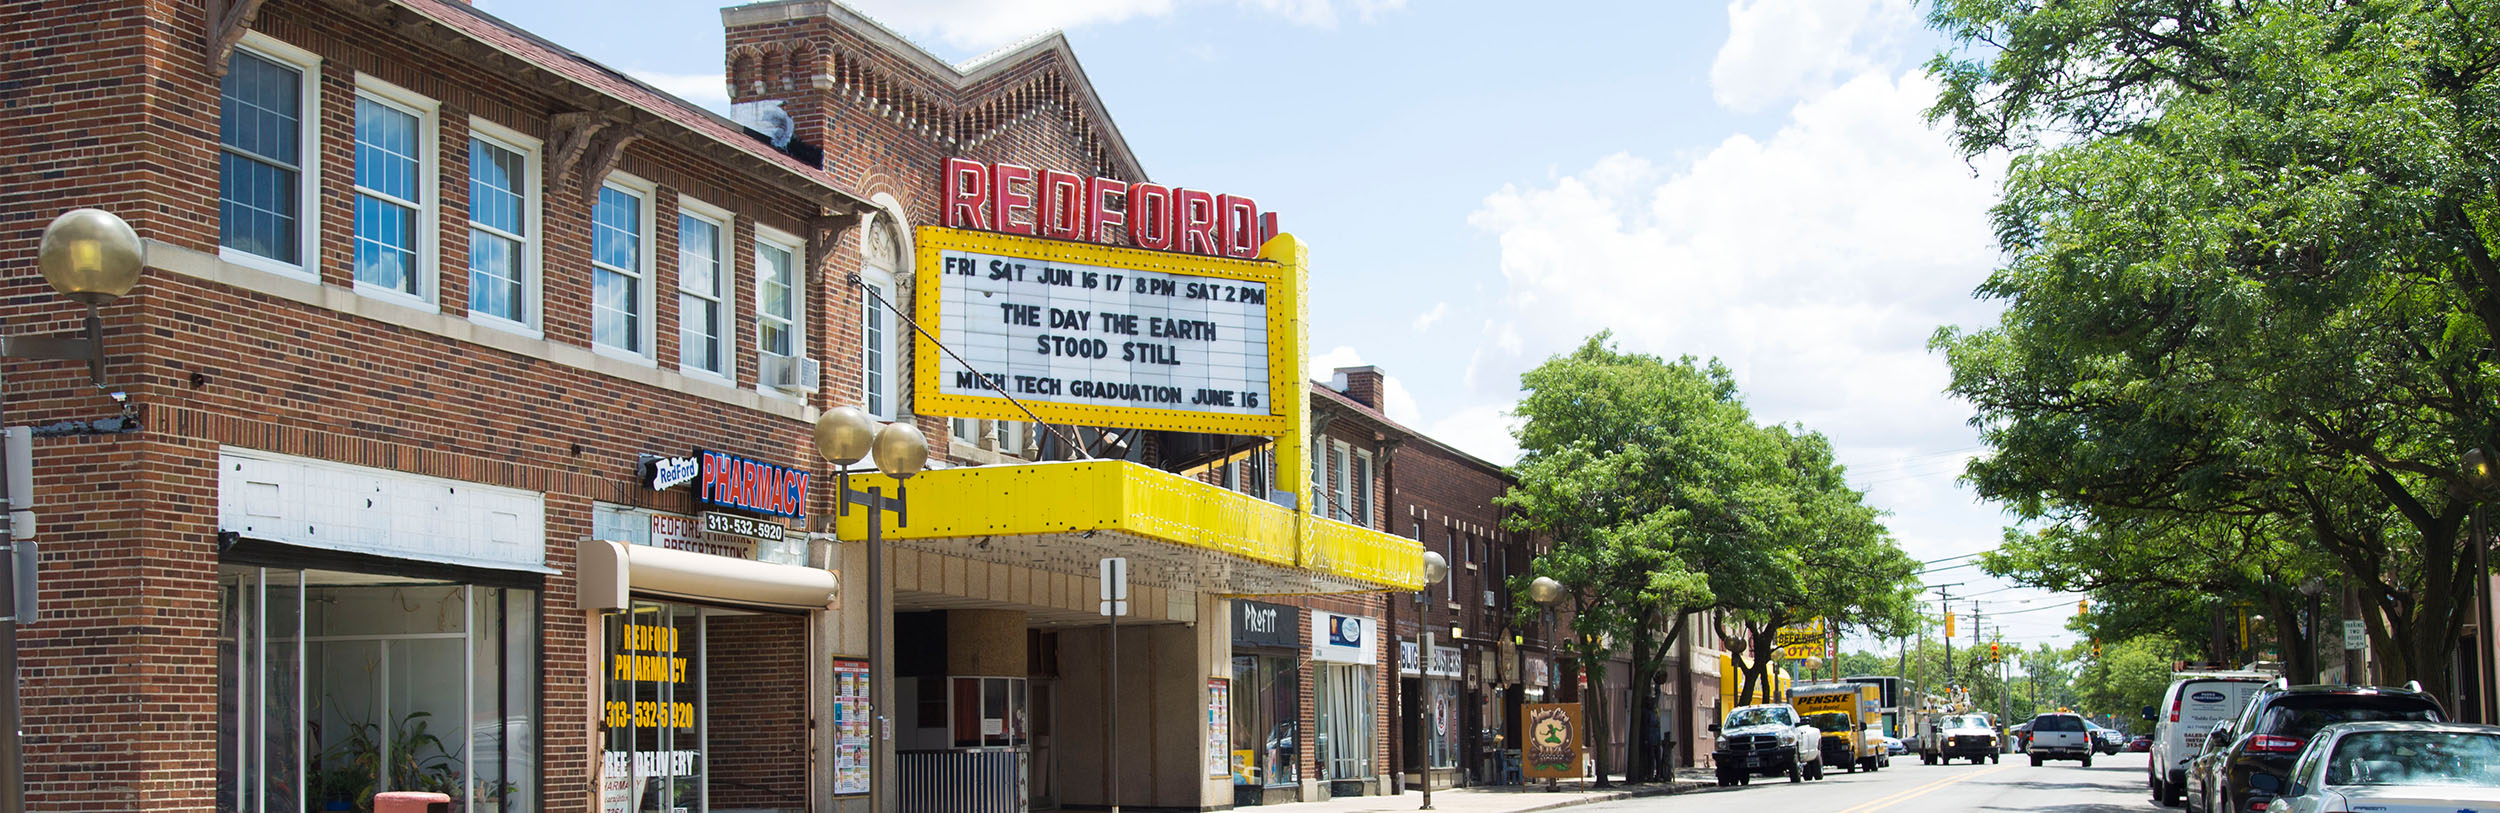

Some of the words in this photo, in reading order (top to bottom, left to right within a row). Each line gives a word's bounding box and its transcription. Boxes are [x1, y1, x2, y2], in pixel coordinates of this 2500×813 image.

[941, 157, 1260, 259] REDFORD
[945, 257, 976, 276] FRI
[989, 260, 1026, 281] SAT
[1037, 267, 1072, 287] JUN
[1082, 272, 1098, 289] 16
[1106, 274, 1123, 291] 17
[1186, 283, 1220, 300] SAT
[1225, 286, 1236, 302] 2
[1240, 287, 1265, 305] PM
[1001, 303, 1040, 327] THE
[1050, 308, 1090, 331] DAY
[1100, 312, 1139, 335] THE
[1150, 317, 1216, 341] EARTH
[1037, 334, 1107, 359] STOOD
[1122, 342, 1181, 365] STILL
[956, 371, 1005, 391] MICH
[1015, 375, 1061, 395] TECH
[1070, 380, 1182, 403] GRADUATION
[1192, 388, 1235, 406] JUNE
[1241, 392, 1259, 408] 16
[660, 461, 695, 484] RedFord
[702, 452, 810, 517] PHARMACY
[708, 514, 782, 540] 313-532-5920
[1245, 602, 1277, 633] PROFIT
[624, 624, 678, 652] REDFORD
[1785, 646, 1823, 657] OTTO
[615, 654, 687, 683] PHARMACY
[1402, 645, 1420, 670] BLIG
[1797, 694, 1851, 705] PENSKE
[606, 701, 693, 728] 313-532-5920
[605, 751, 627, 776] REE
[635, 751, 694, 776] DELIVERY
